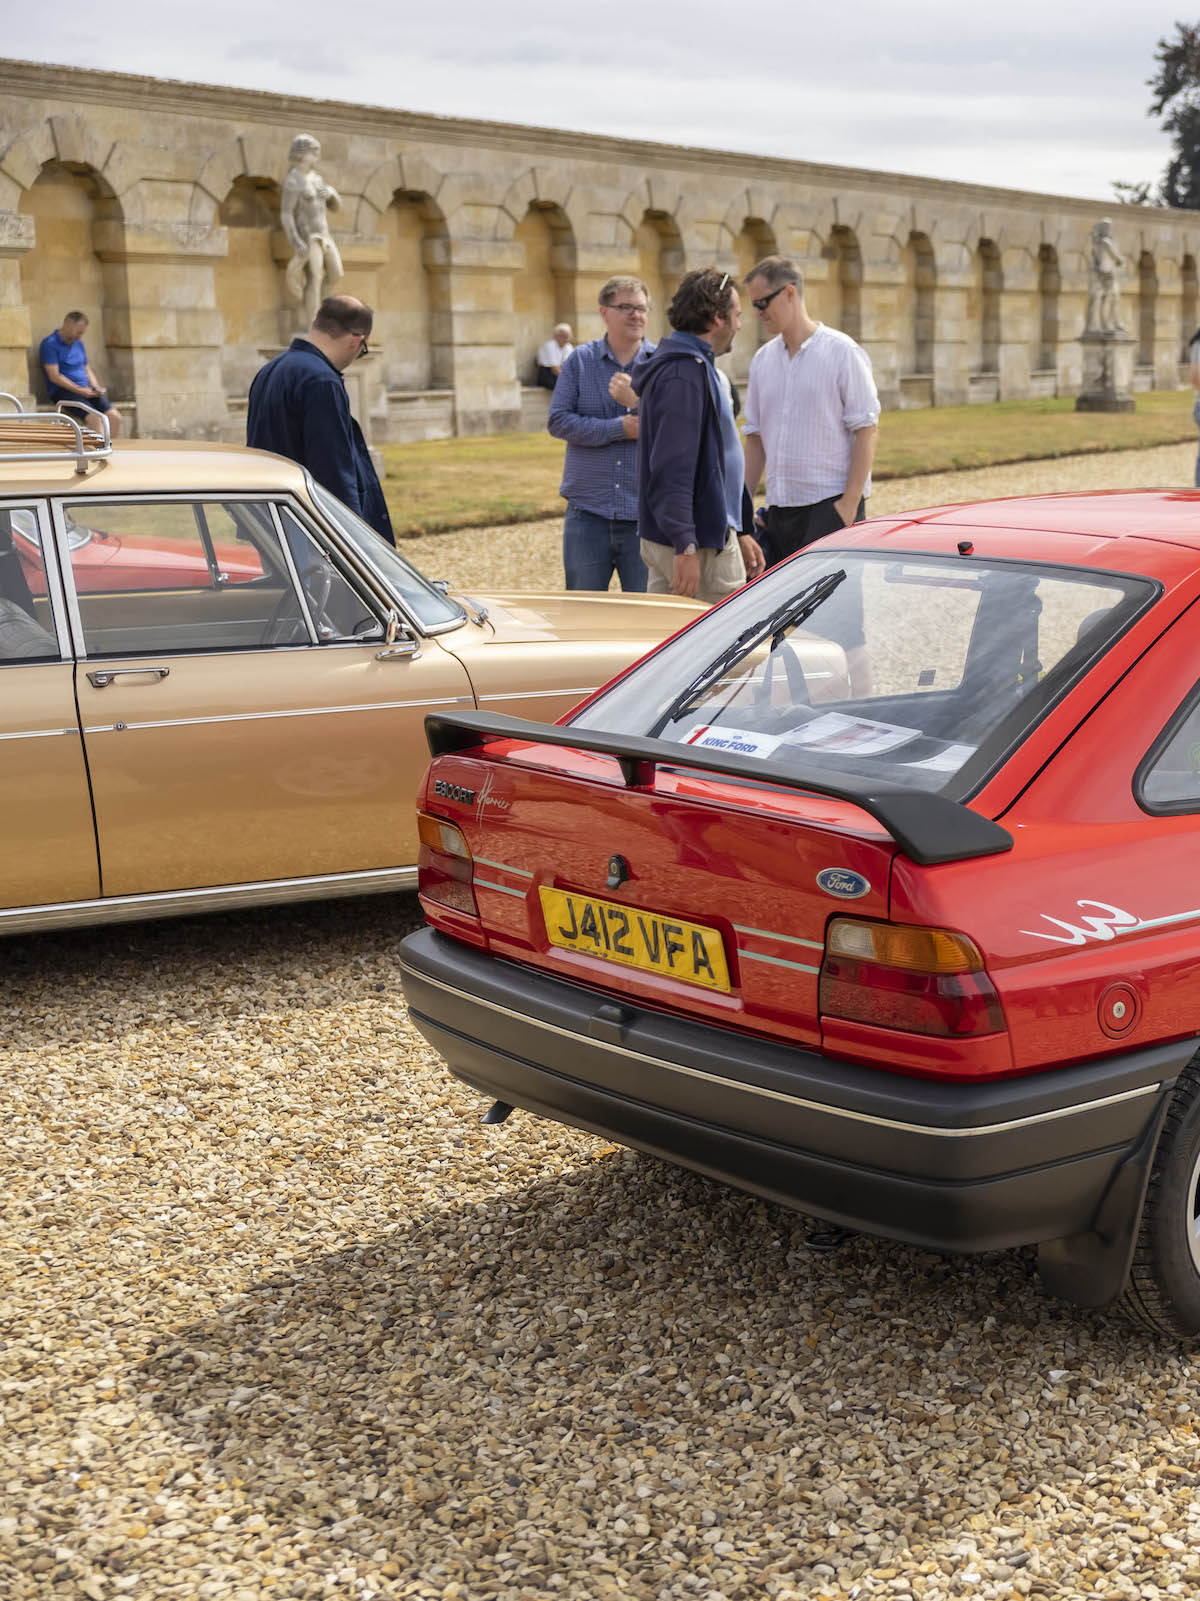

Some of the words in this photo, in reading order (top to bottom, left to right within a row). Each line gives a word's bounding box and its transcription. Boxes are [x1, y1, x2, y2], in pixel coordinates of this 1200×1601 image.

[701, 737, 730, 748] KING
[726, 741, 758, 753] FORD
[434, 779, 476, 806] ESCORT
[476, 772, 511, 829] Harrier
[827, 872, 856, 892] Ford
[558, 897, 635, 957] J412
[637, 916, 716, 980] VFA
